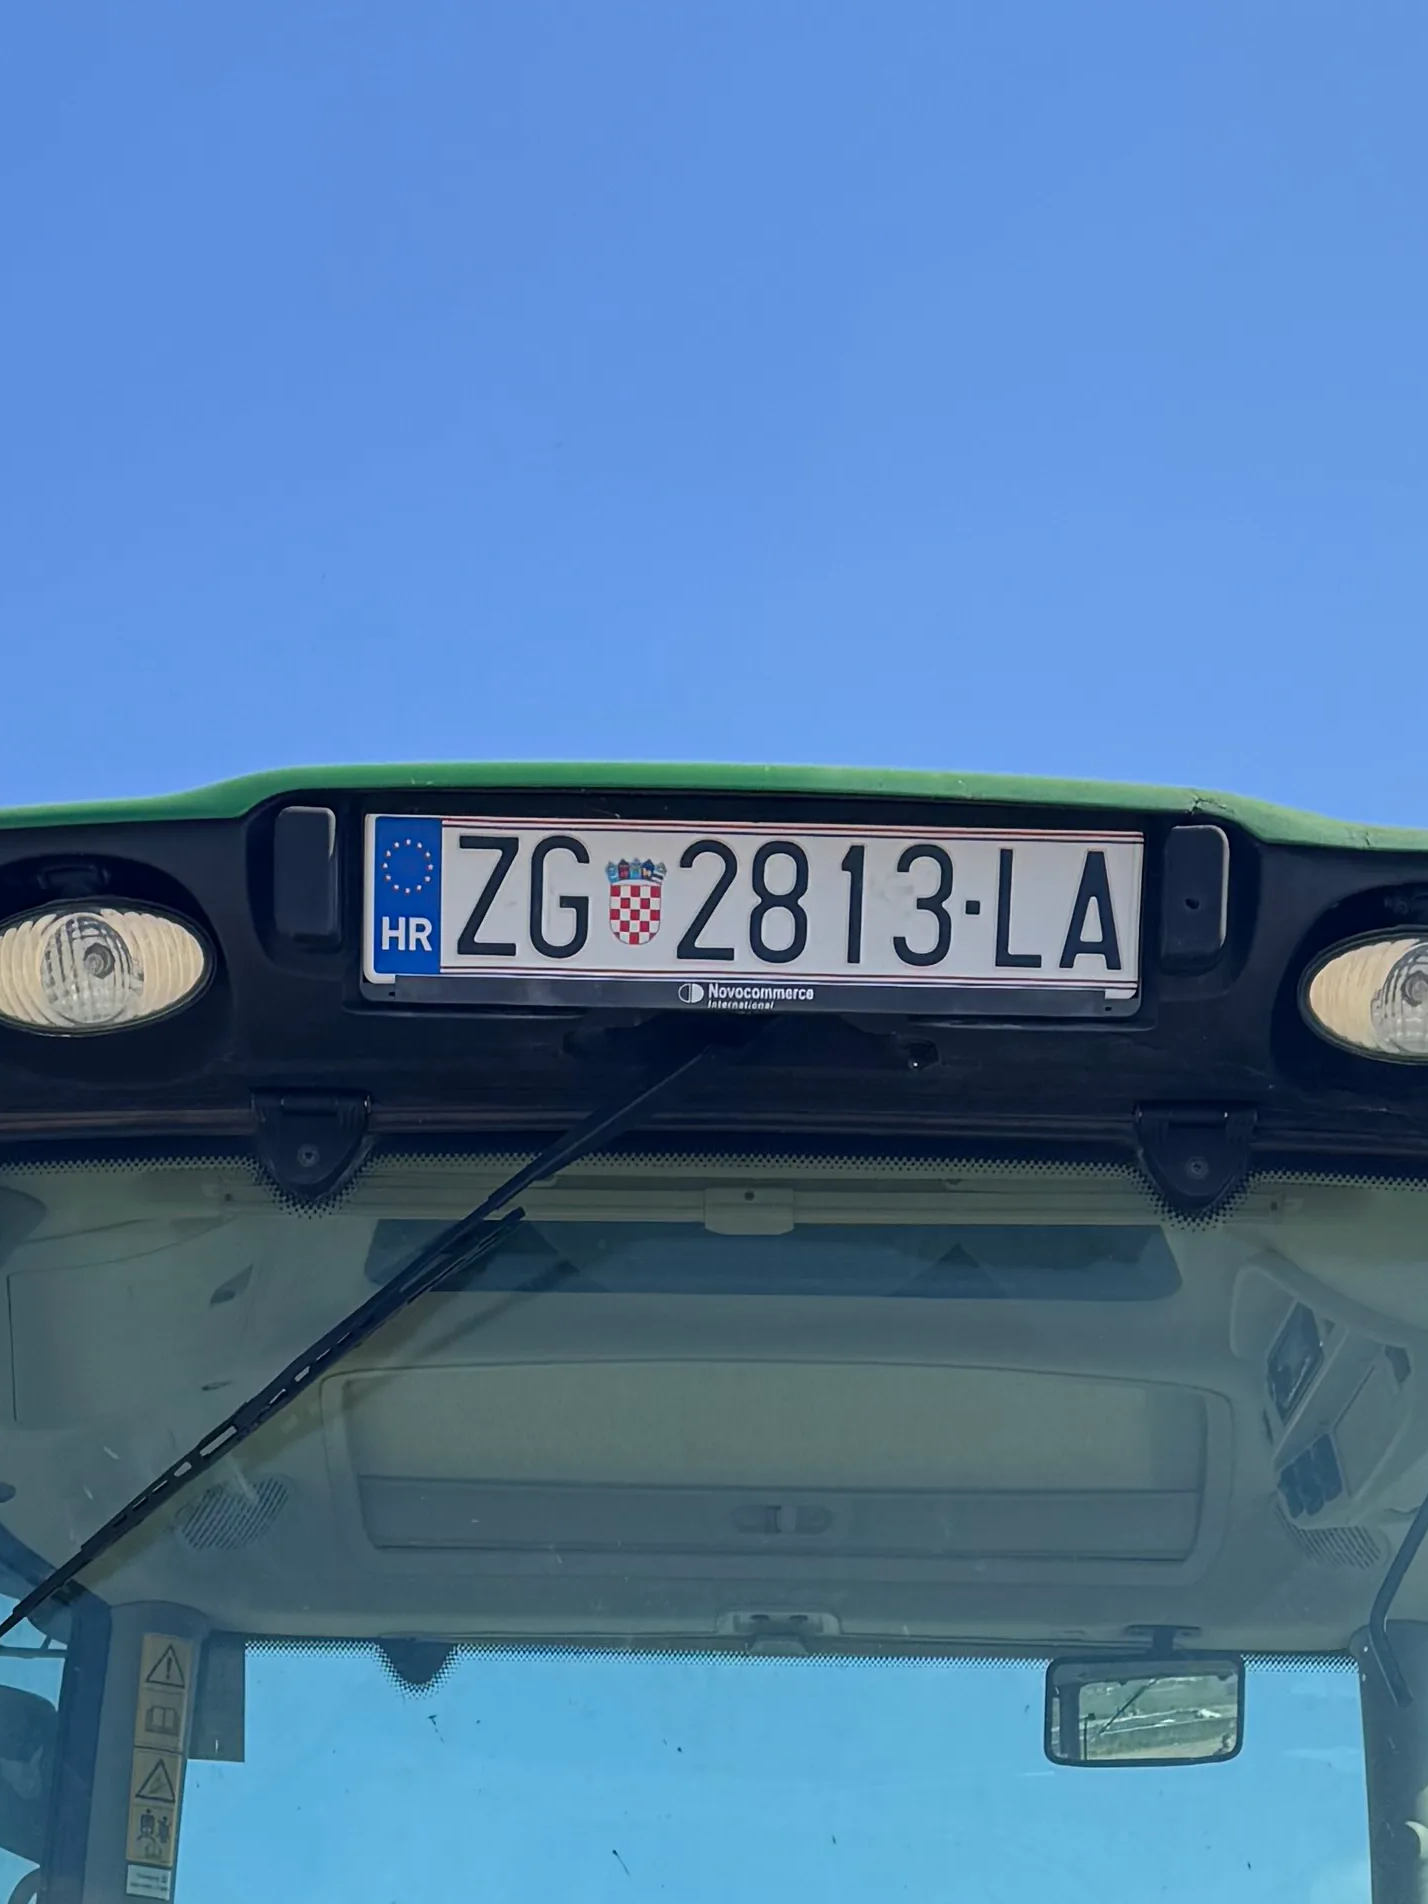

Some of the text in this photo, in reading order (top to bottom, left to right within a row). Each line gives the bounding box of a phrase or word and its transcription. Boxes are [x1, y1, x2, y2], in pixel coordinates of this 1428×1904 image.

[457, 834, 590, 959] ZG
[381, 916, 433, 951] HR
[707, 999, 775, 1010] International
[708, 983, 814, 1000] Novocommerce
